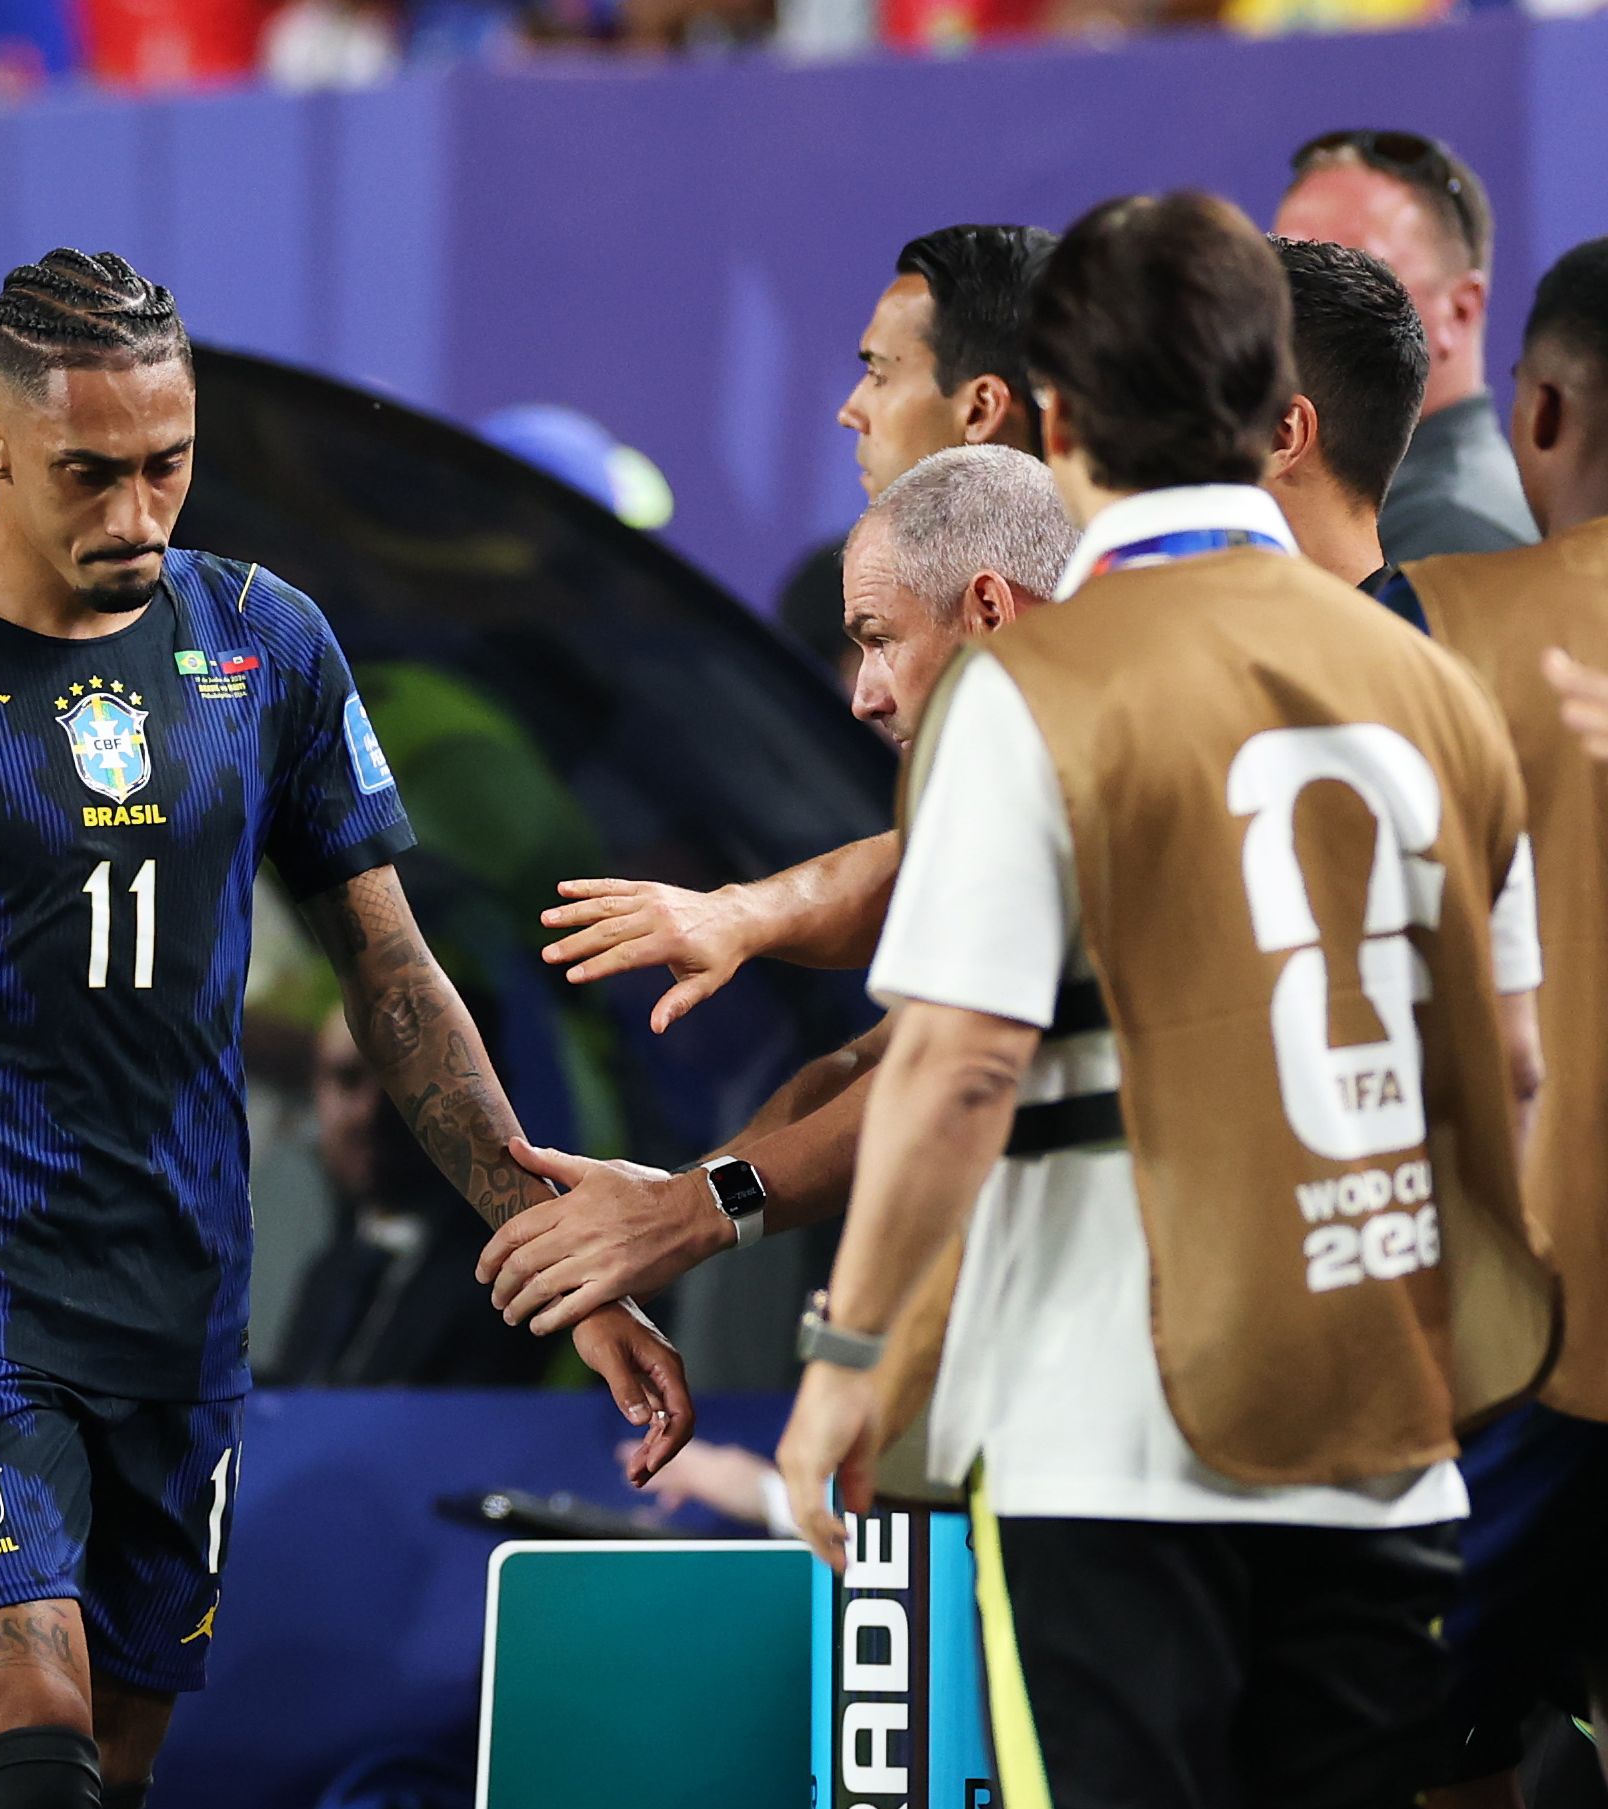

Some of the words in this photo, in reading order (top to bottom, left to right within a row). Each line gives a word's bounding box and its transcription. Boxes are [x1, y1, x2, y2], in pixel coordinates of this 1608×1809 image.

[94, 738, 122, 751] CBF
[82, 804, 167, 827] BRASIL
[82, 859, 156, 989] 11
[209, 1440, 242, 1574] 1
[843, 1512, 909, 1809] ADE
